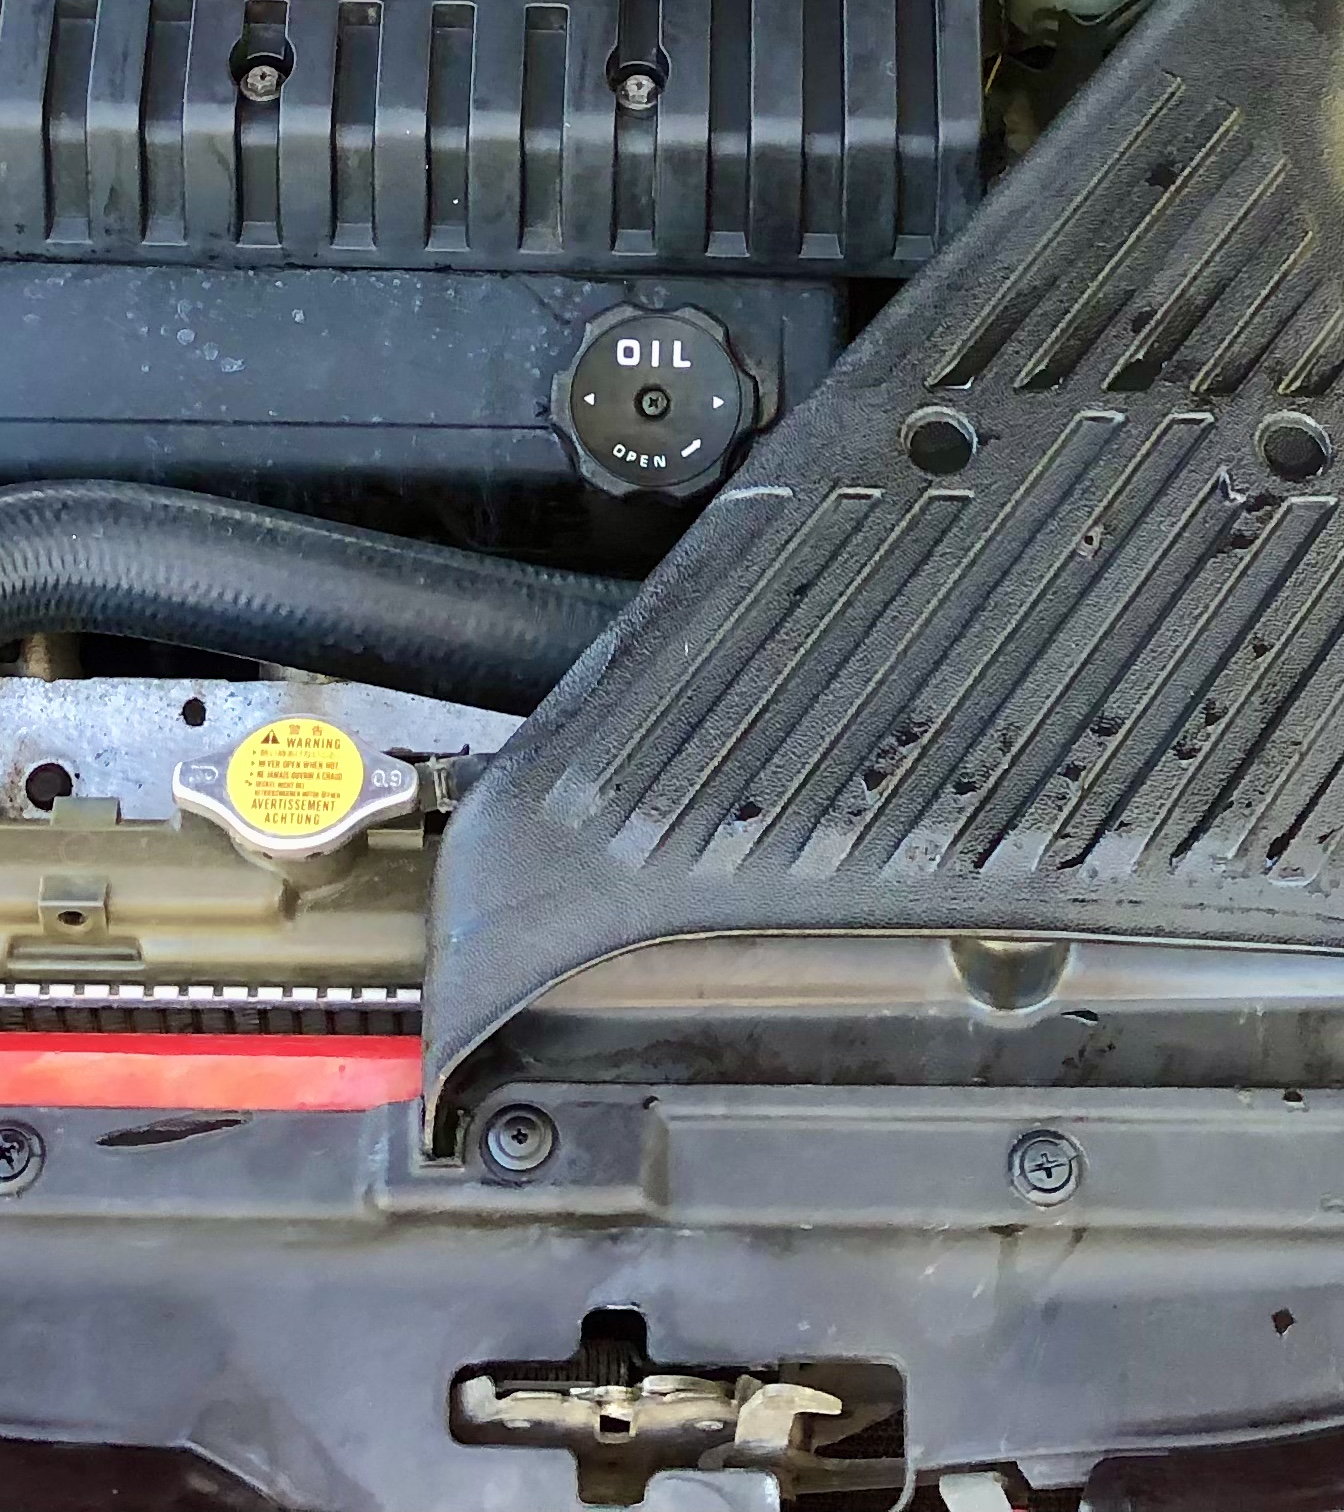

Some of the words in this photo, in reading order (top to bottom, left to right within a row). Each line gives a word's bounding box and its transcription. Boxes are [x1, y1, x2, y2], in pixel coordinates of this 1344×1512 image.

[616, 338, 692, 368] OIL
[612, 443, 667, 469] OPEN
[286, 737, 341, 750] WARNING
[258, 760, 280, 768] NEVER
[250, 798, 336, 812] AVERTISSEMENT
[264, 812, 321, 825] ACHTUNG
